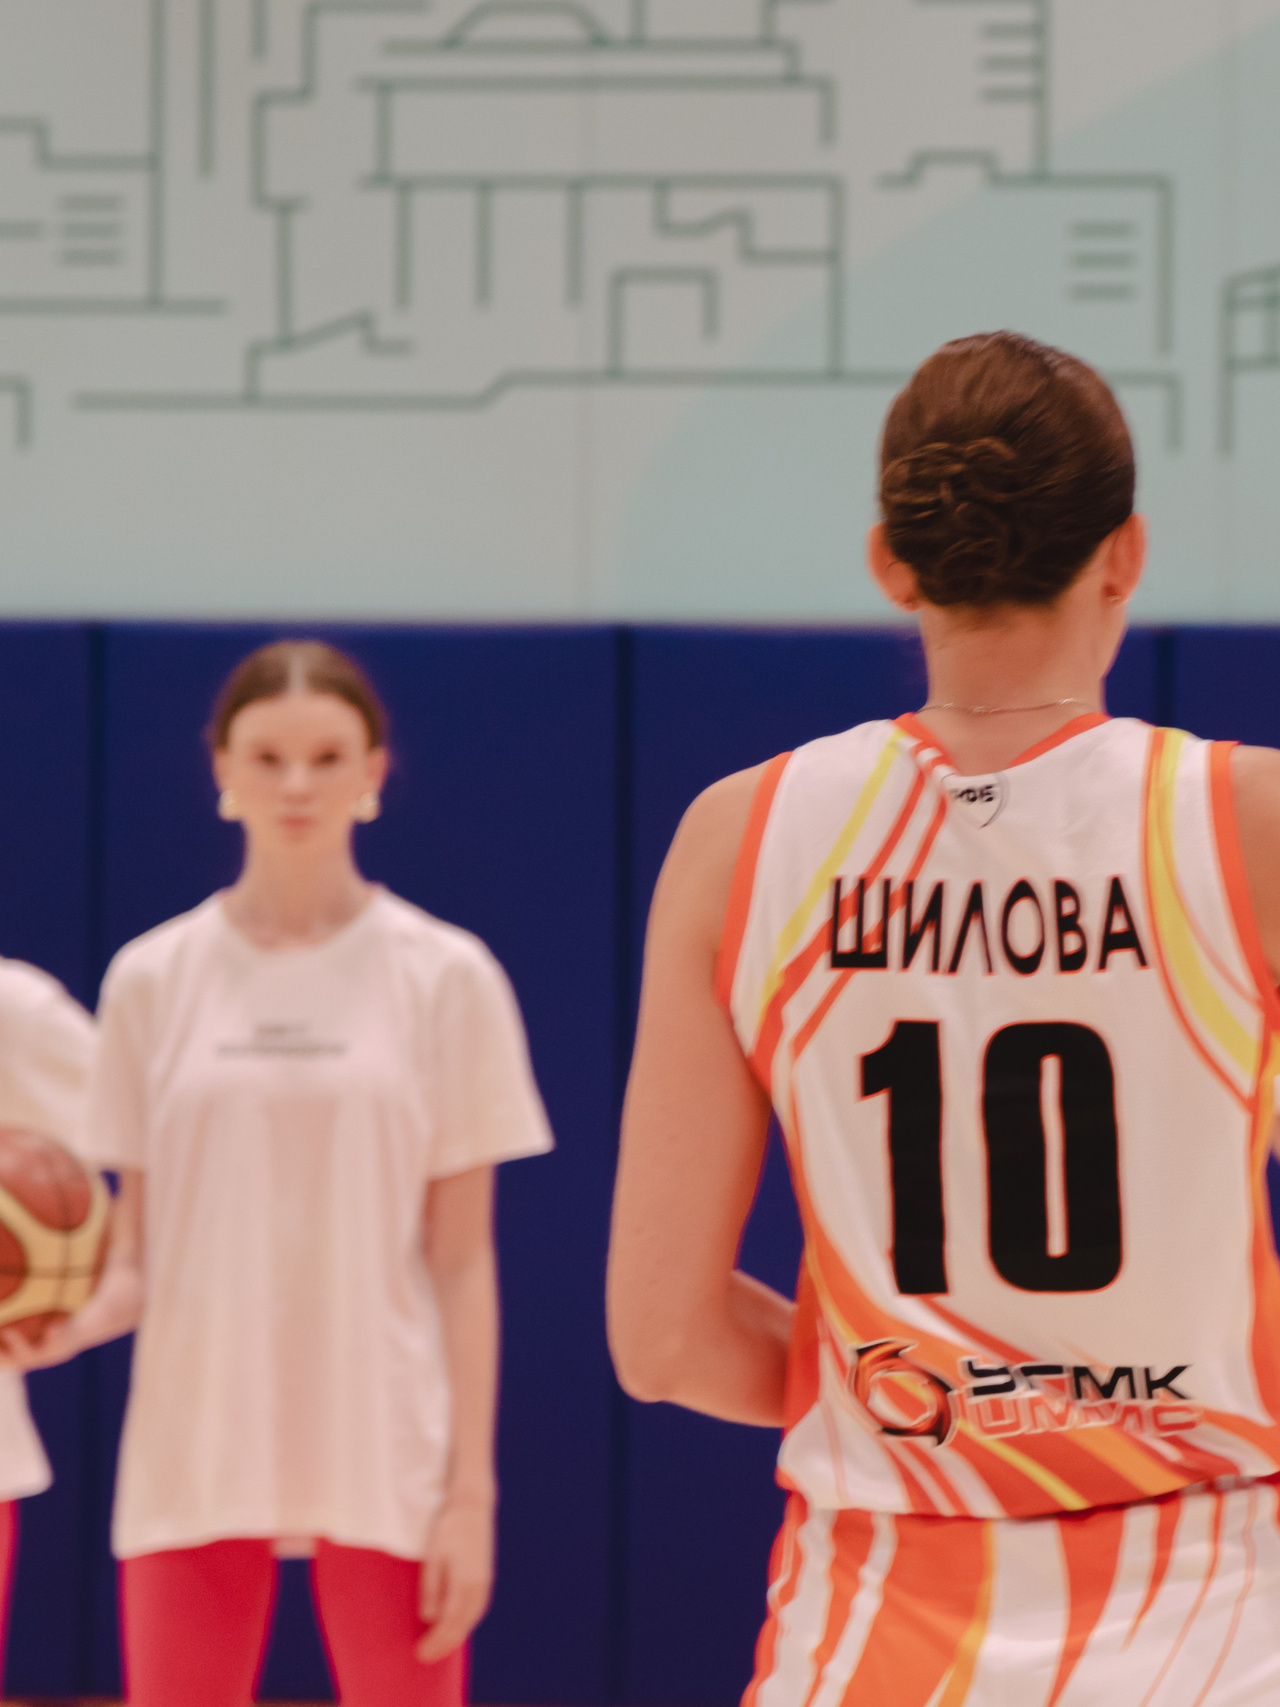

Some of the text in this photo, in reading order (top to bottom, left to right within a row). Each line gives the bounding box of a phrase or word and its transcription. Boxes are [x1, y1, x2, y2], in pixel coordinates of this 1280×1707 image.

[829, 875, 1151, 976] ШИЛОВА
[856, 1019, 1123, 1295] 10
[961, 1357, 1193, 1400] УГМК
